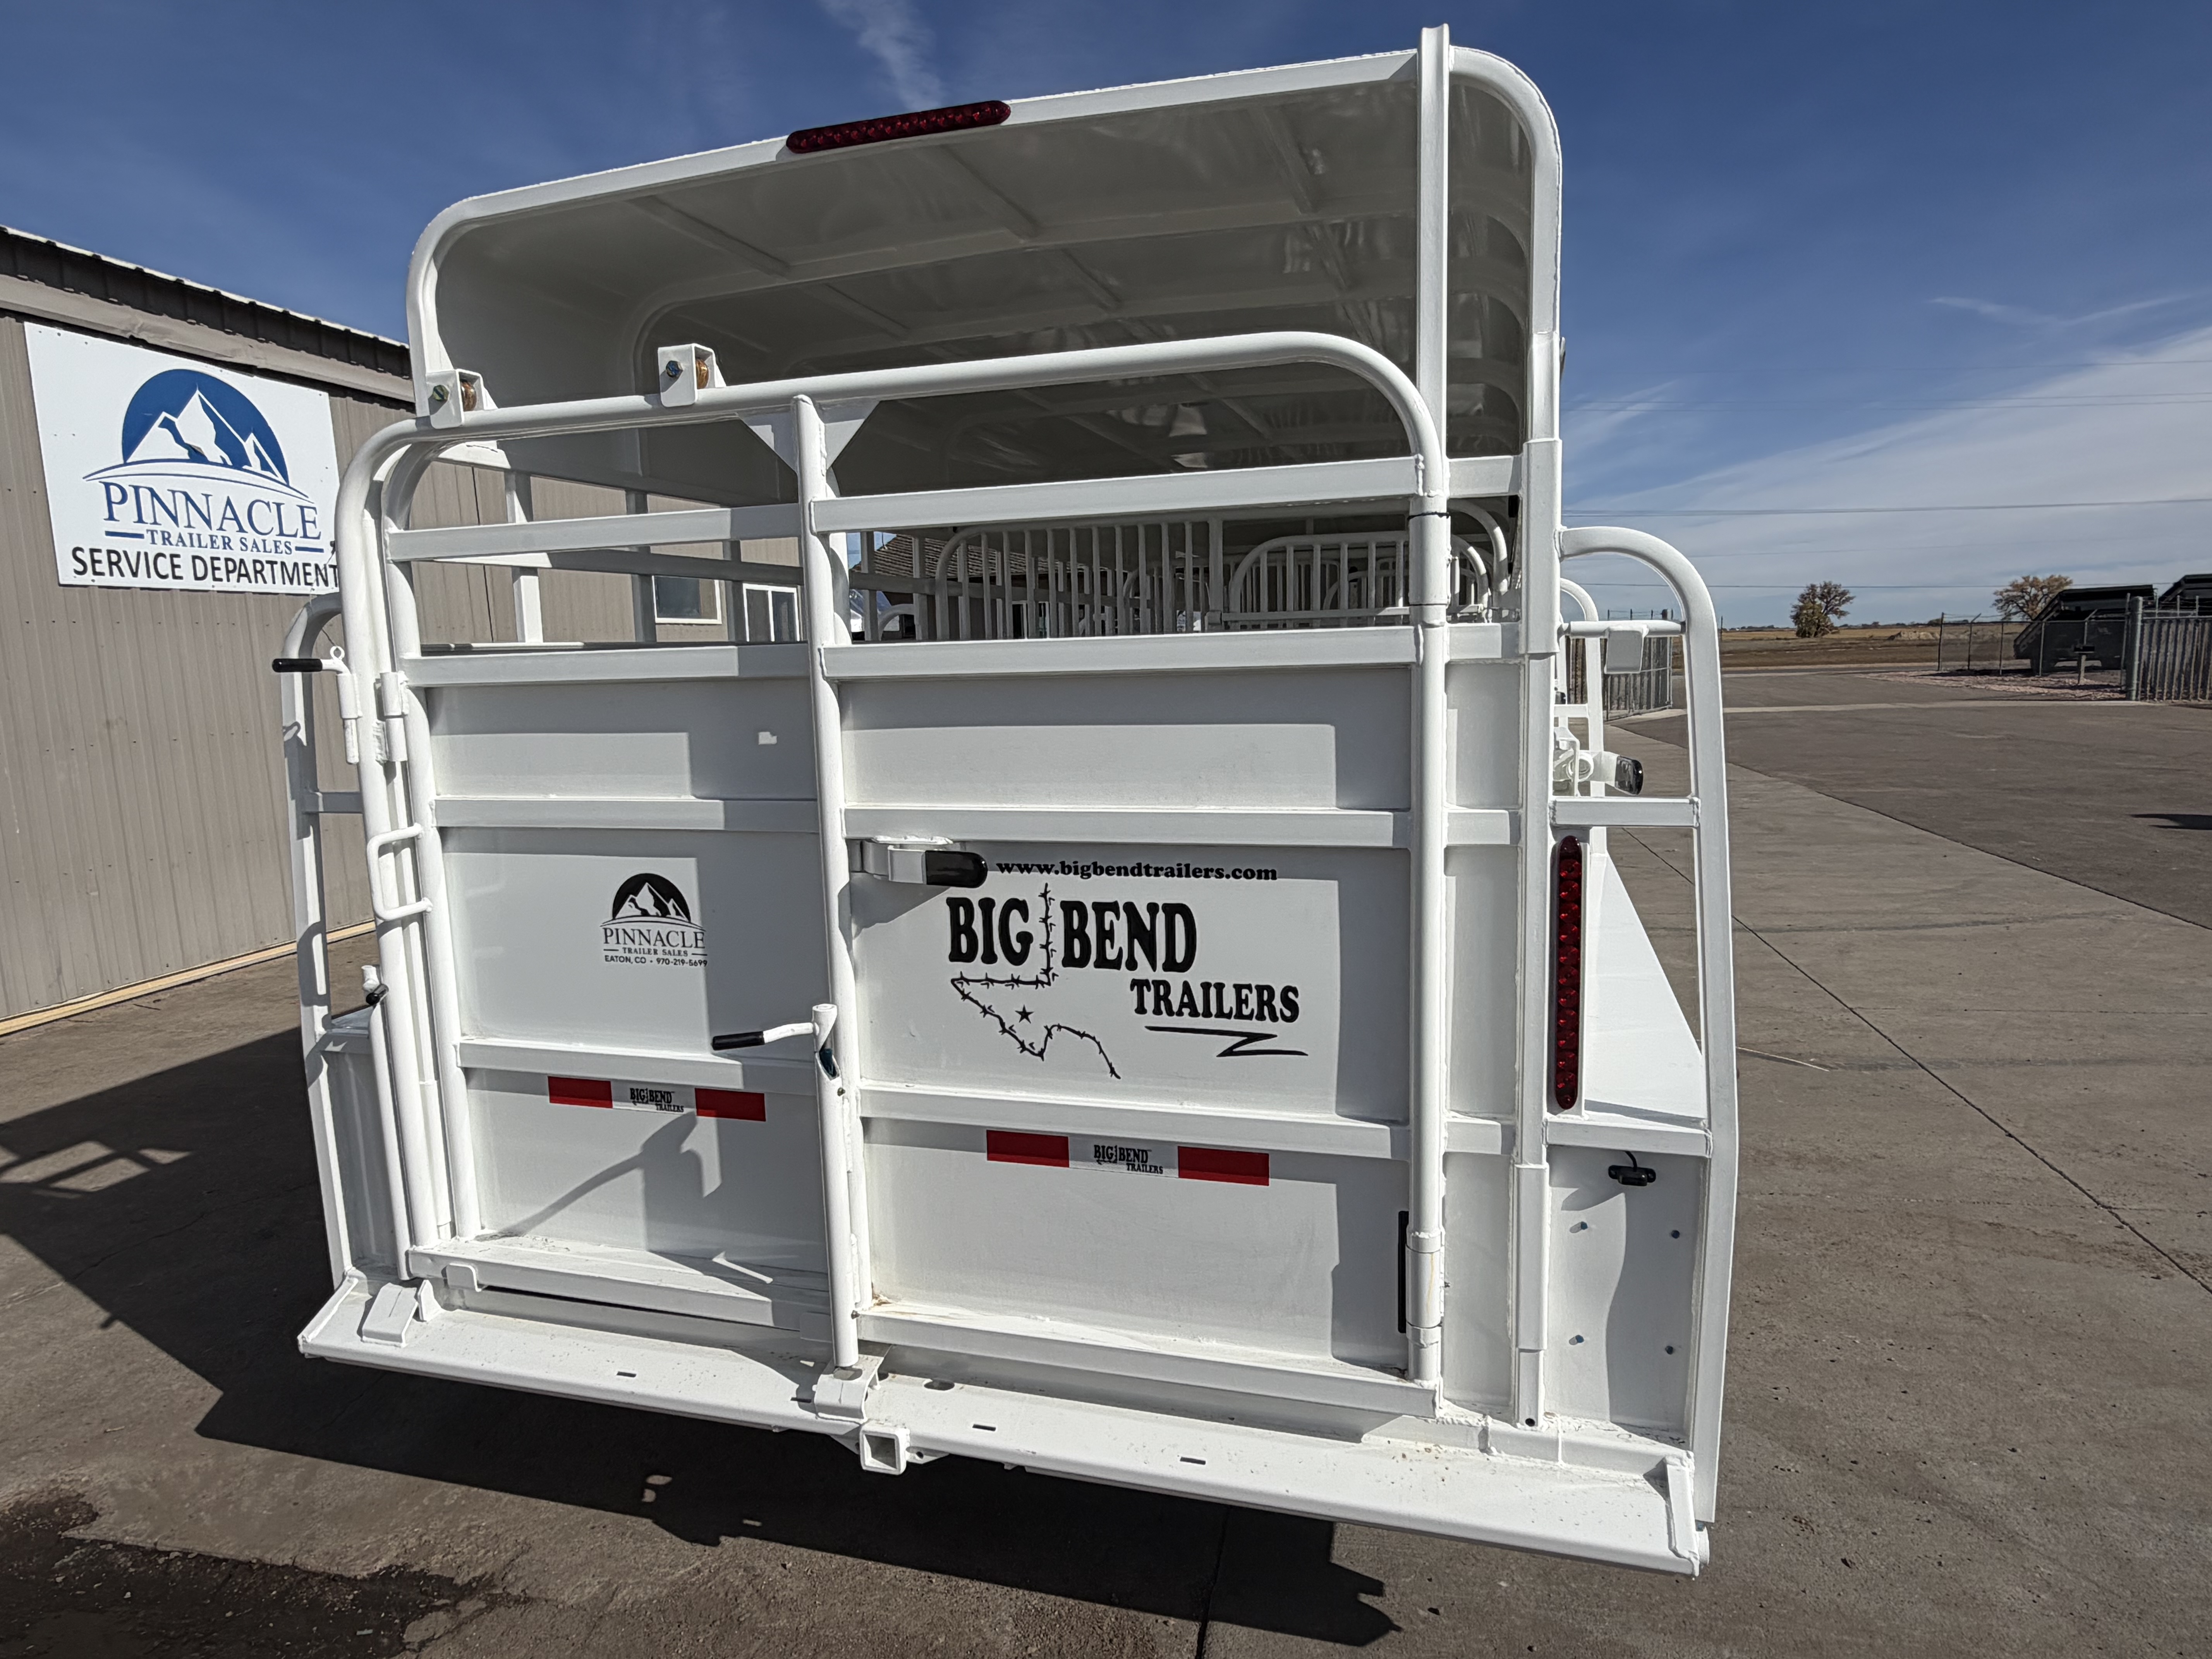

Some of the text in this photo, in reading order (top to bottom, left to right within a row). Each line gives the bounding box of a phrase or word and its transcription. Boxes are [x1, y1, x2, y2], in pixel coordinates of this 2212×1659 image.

[99, 481, 322, 540] PINNACLE
[146, 529, 292, 555] TRAILER SALES
[71, 547, 338, 588] SERVICE DEPARTMENT
[996, 860, 1278, 881] www.bigbendtrailers.com
[603, 927, 706, 949] PINNACLE
[946, 897, 1197, 972] BIG BEND
[605, 955, 633, 964] EATON,
[656, 958, 708, 967] 970-219-5699
[622, 947, 658, 955] TRAILER
[1130, 979, 1299, 1022] TRAILERS
[630, 1088, 672, 1104] BIG BEND
[655, 1103, 684, 1112] TRAILERS
[1094, 1145, 1149, 1164] BIG BEND
[1127, 1163, 1163, 1174] TRAILERS
